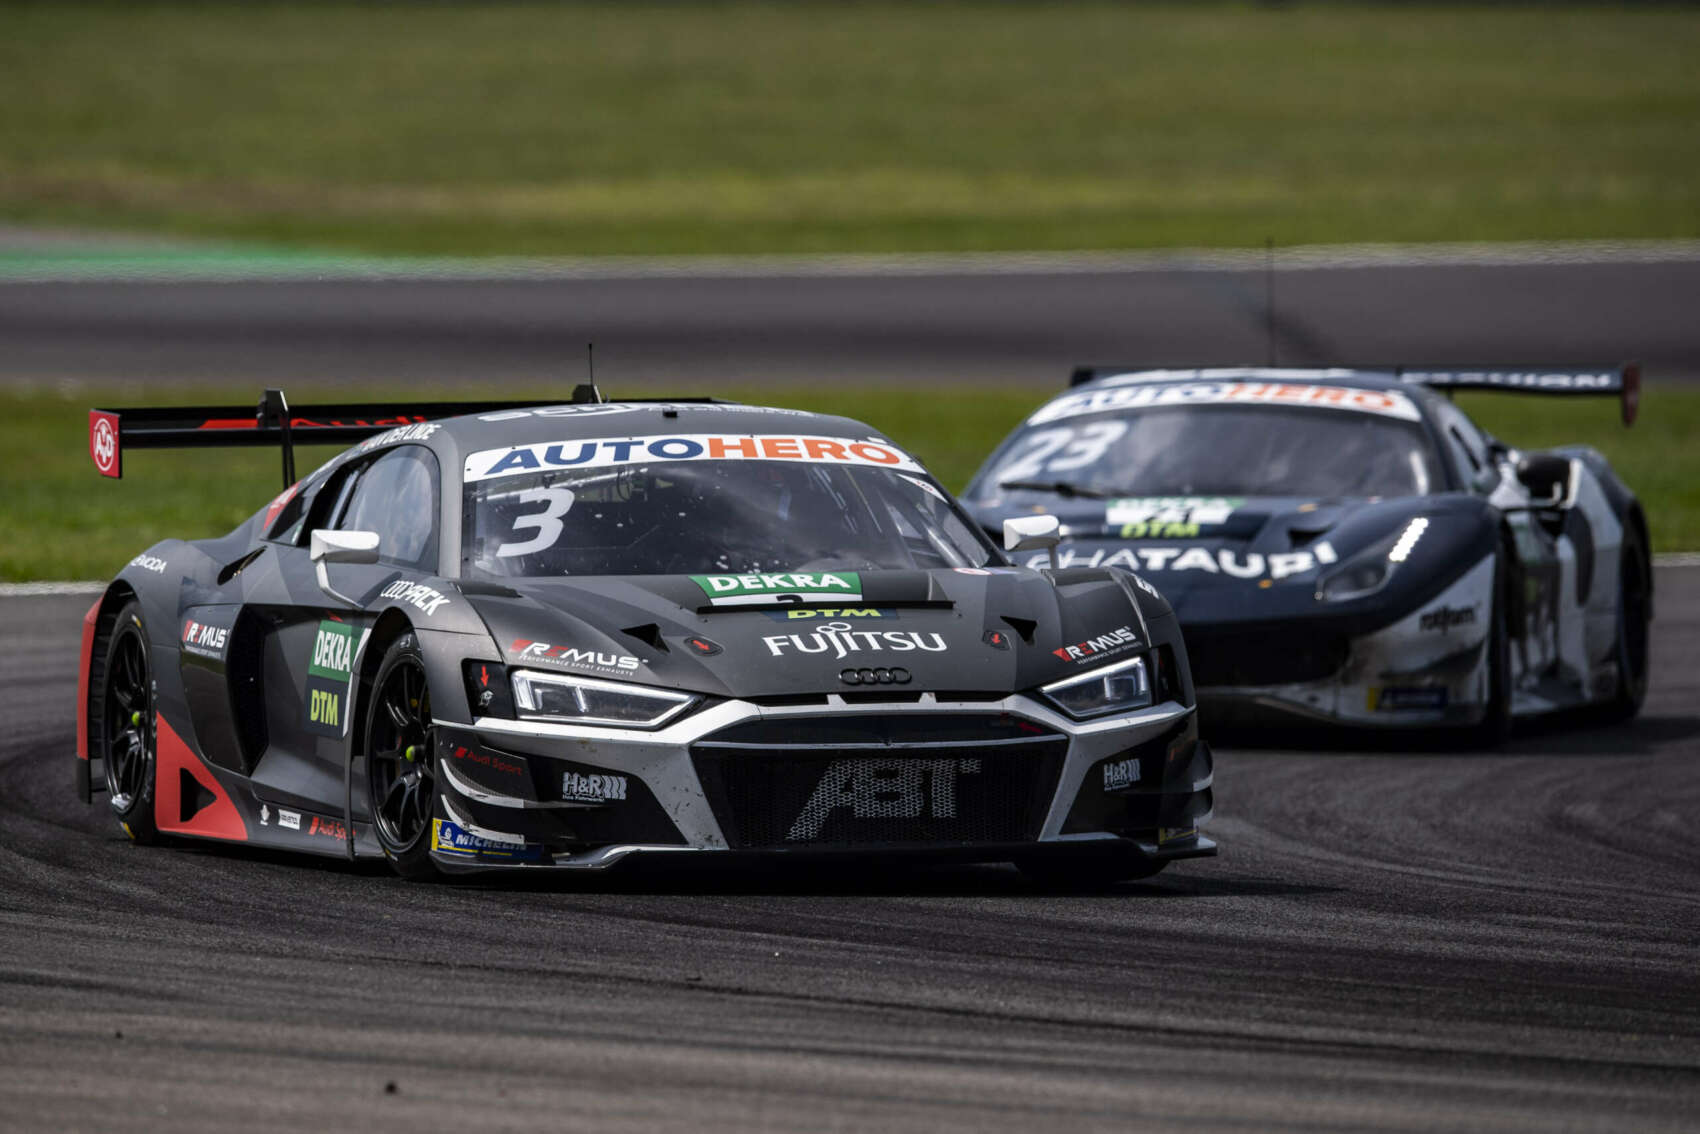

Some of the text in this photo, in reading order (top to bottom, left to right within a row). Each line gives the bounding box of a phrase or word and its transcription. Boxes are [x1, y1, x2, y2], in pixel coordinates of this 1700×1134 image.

[484, 437, 900, 475] AUTOHERO
[999, 419, 1128, 483] 23
[496, 488, 575, 558] 3
[707, 573, 851, 592] DEKRA
[787, 609, 882, 619] DTM
[187, 621, 227, 648] REMUS
[762, 628, 948, 659] FUJITSU
[1065, 628, 1137, 660] REMUS
[314, 630, 352, 673] DEKRA
[522, 642, 639, 670] REMUS
[310, 689, 339, 726] DTM
[562, 771, 604, 797] H&R
[785, 759, 958, 840] ABT
